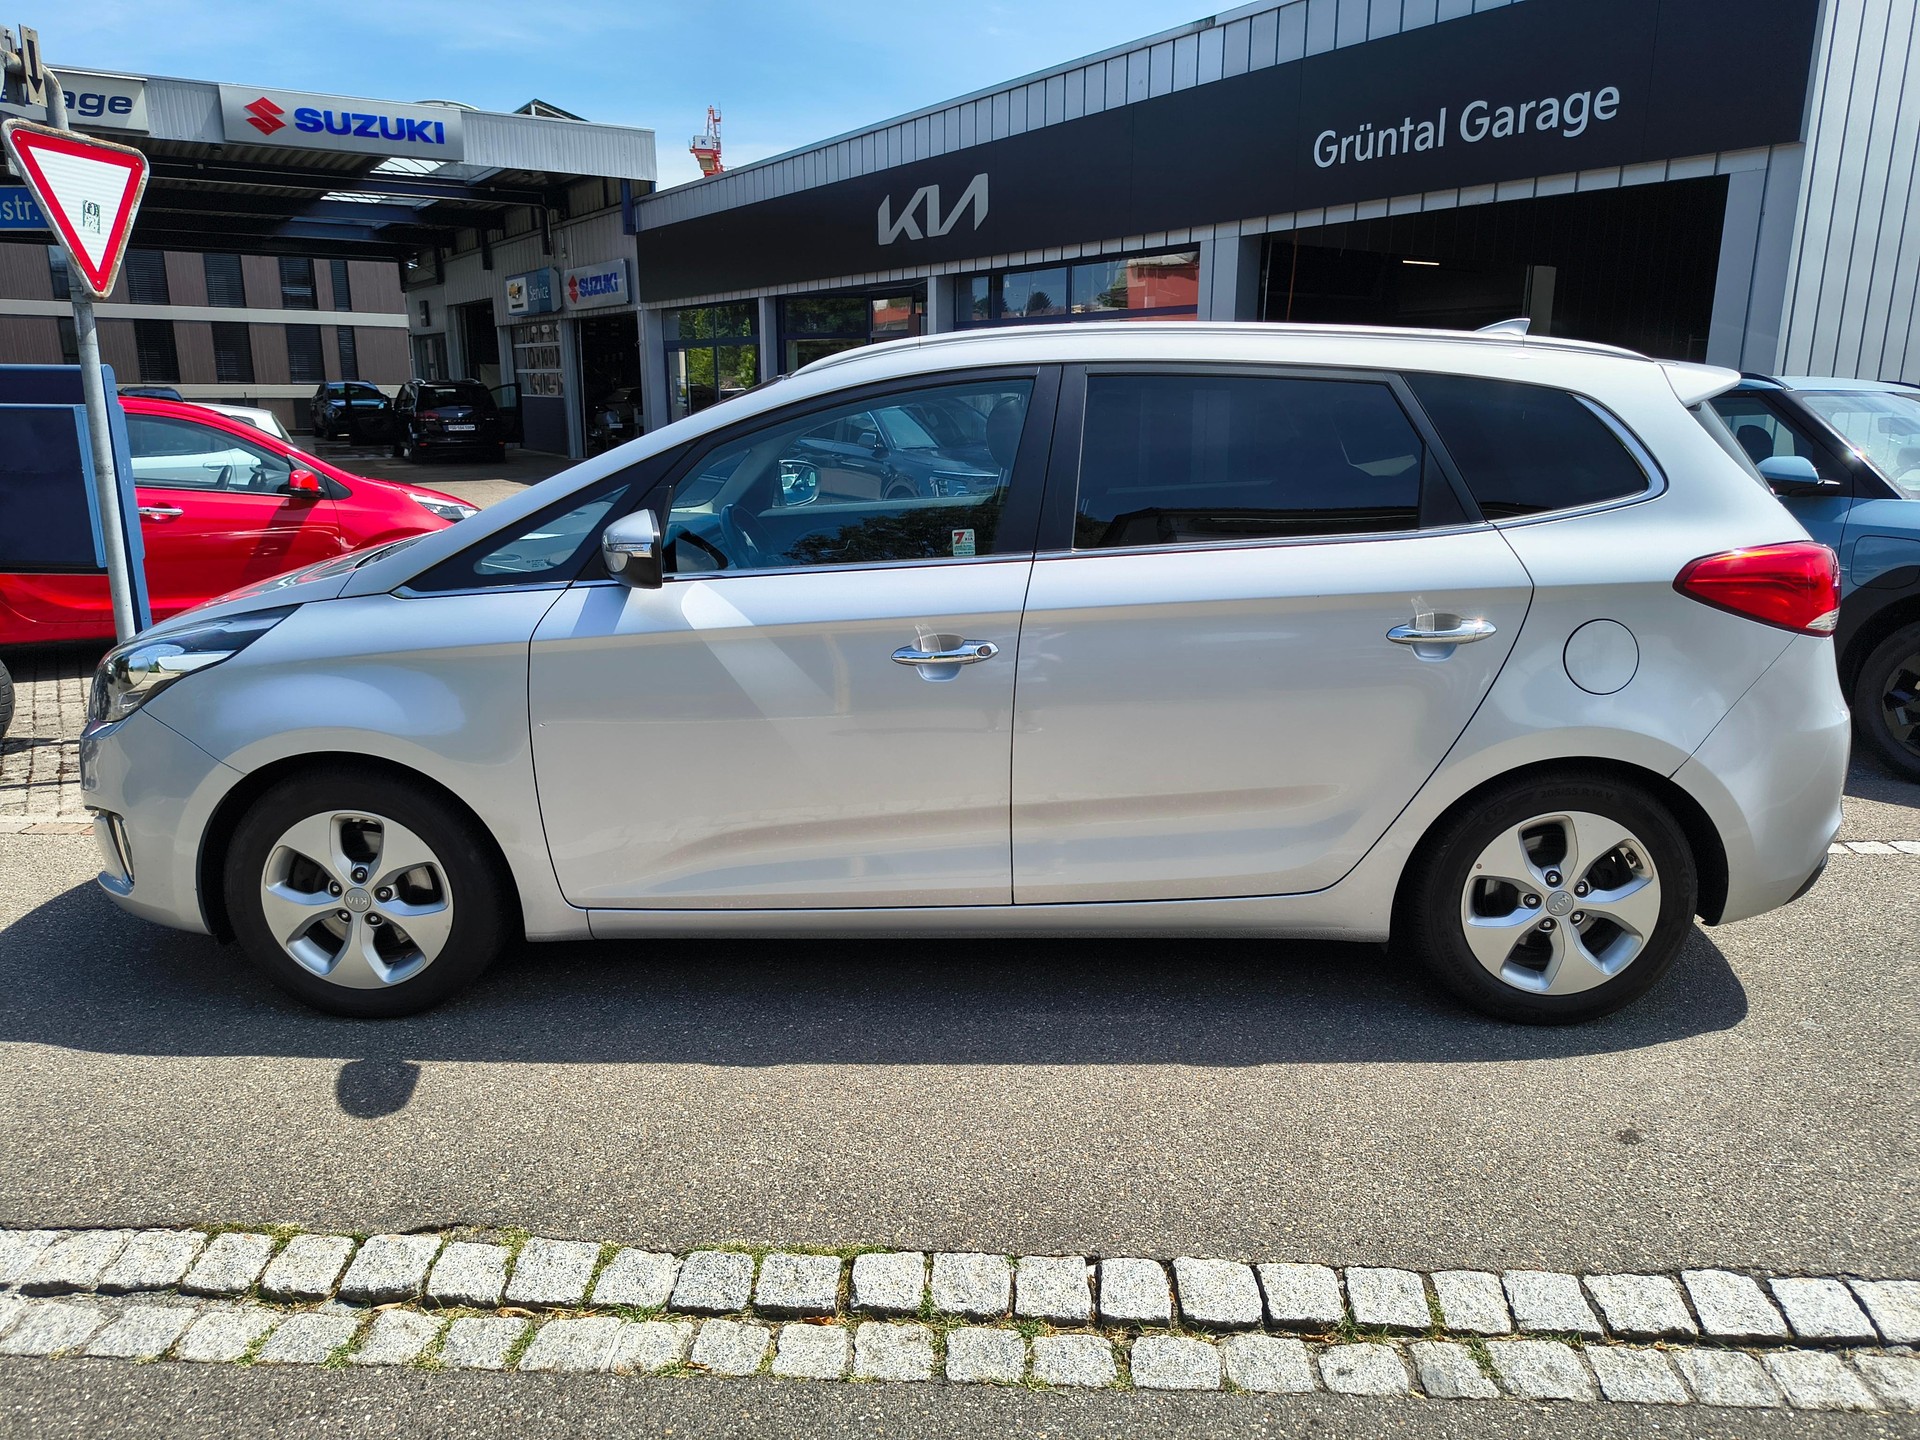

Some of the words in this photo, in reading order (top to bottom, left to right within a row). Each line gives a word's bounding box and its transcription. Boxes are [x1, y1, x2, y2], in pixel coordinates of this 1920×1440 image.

[294, 107, 445, 145] SUZUKI
[1313, 107, 1447, 168] Grüntal
[1459, 85, 1620, 138] Garage
[0, 194, 39, 221] str.
[878, 172, 989, 246] KIA
[529, 285, 549, 301] Service
[578, 272, 619, 298] SUZUKI
[954, 531, 966, 544] 7
[347, 896, 368, 905] KIA
[1551, 894, 1570, 912] KIA
